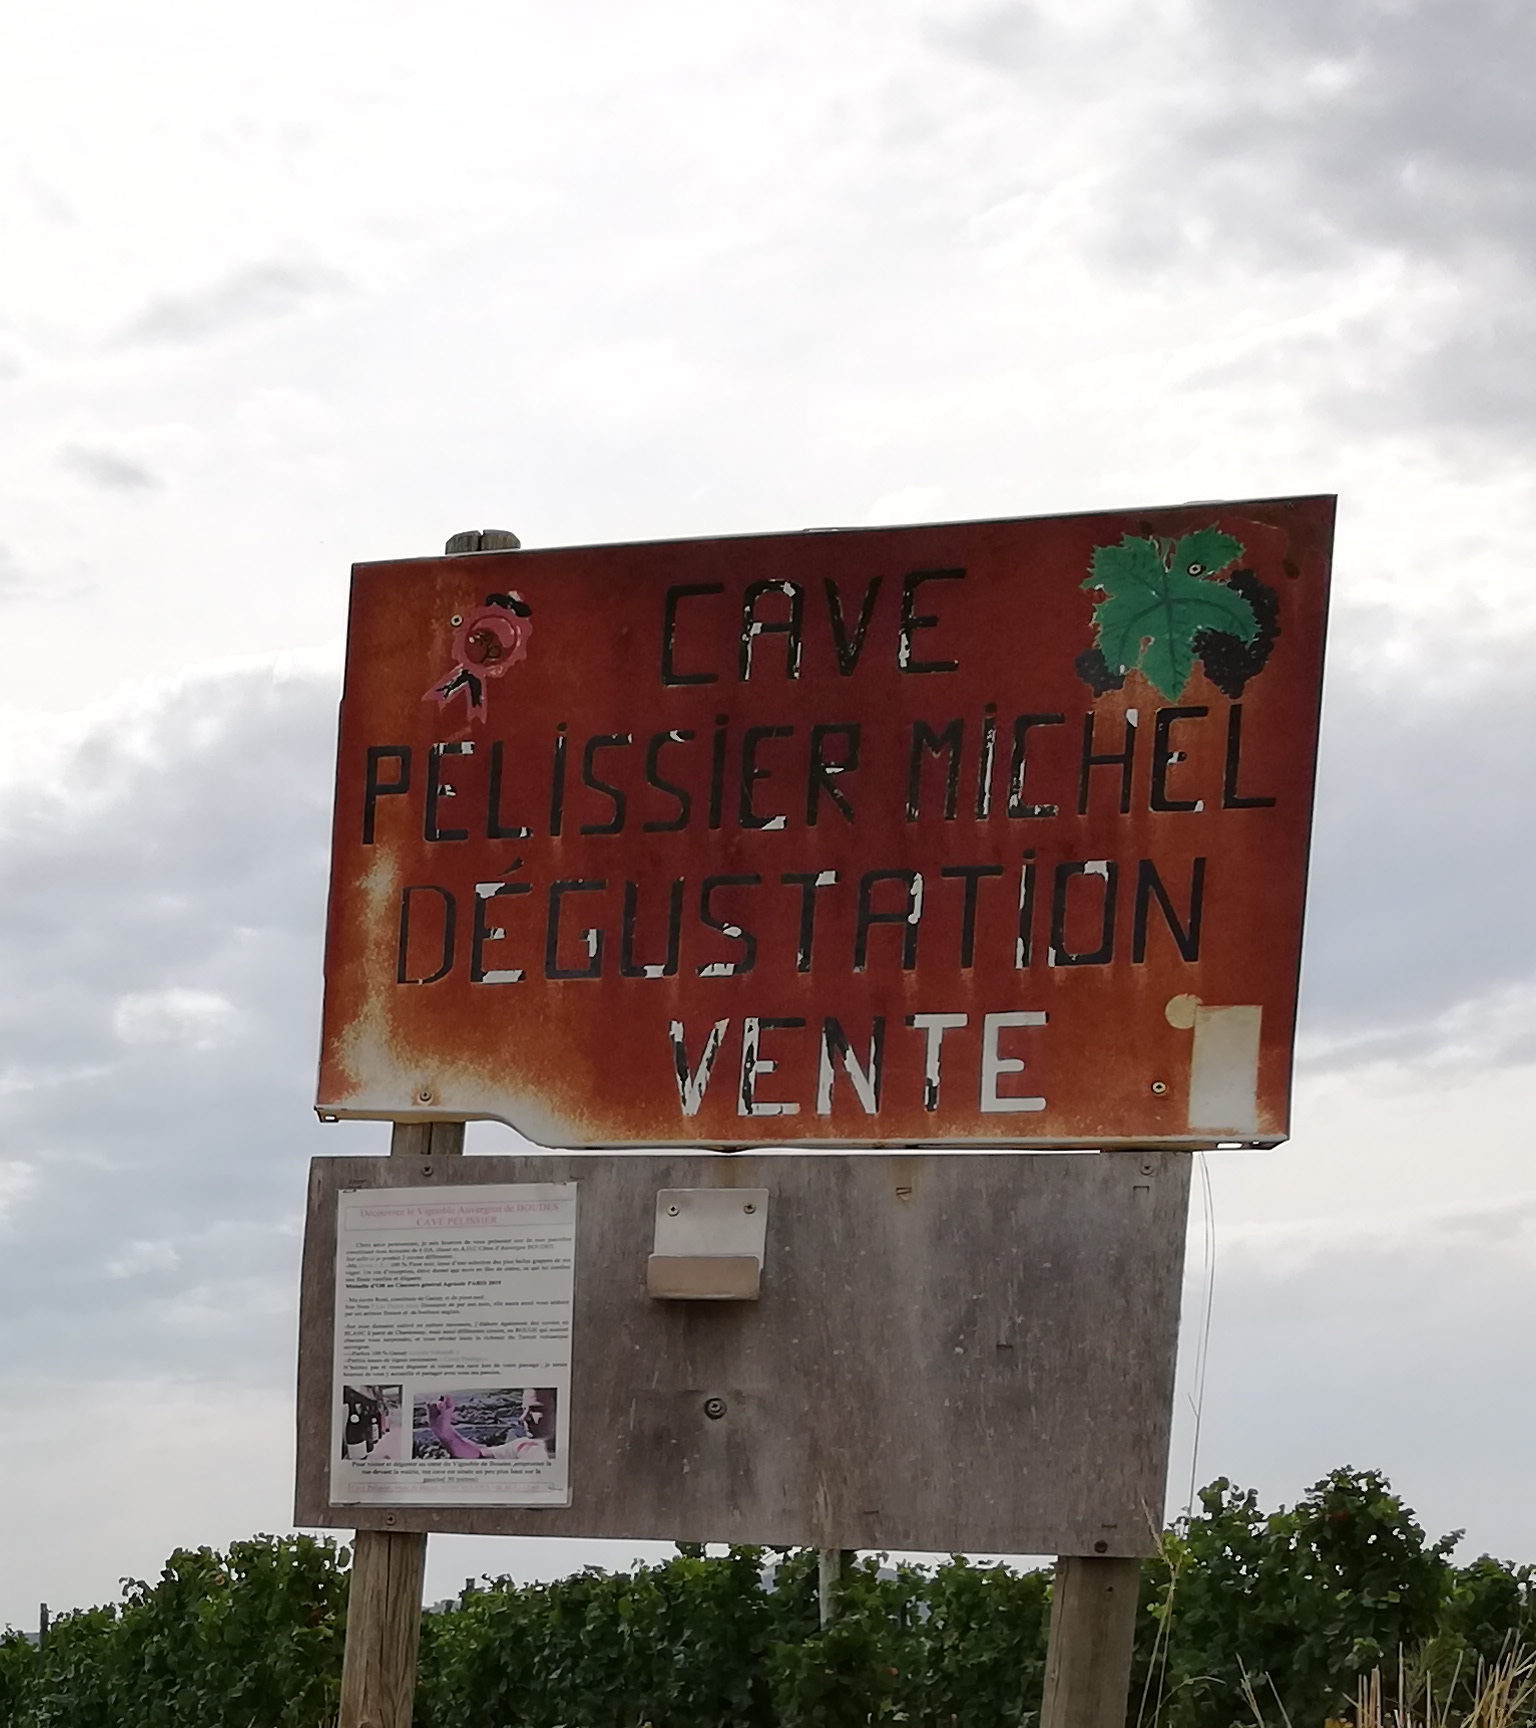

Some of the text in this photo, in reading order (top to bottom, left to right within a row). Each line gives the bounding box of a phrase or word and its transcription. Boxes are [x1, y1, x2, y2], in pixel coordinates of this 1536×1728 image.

[661, 568, 966, 687] CAVE
[668, 1010, 1050, 1117] VENTE
[416, 1218, 443, 1226] CAVE
